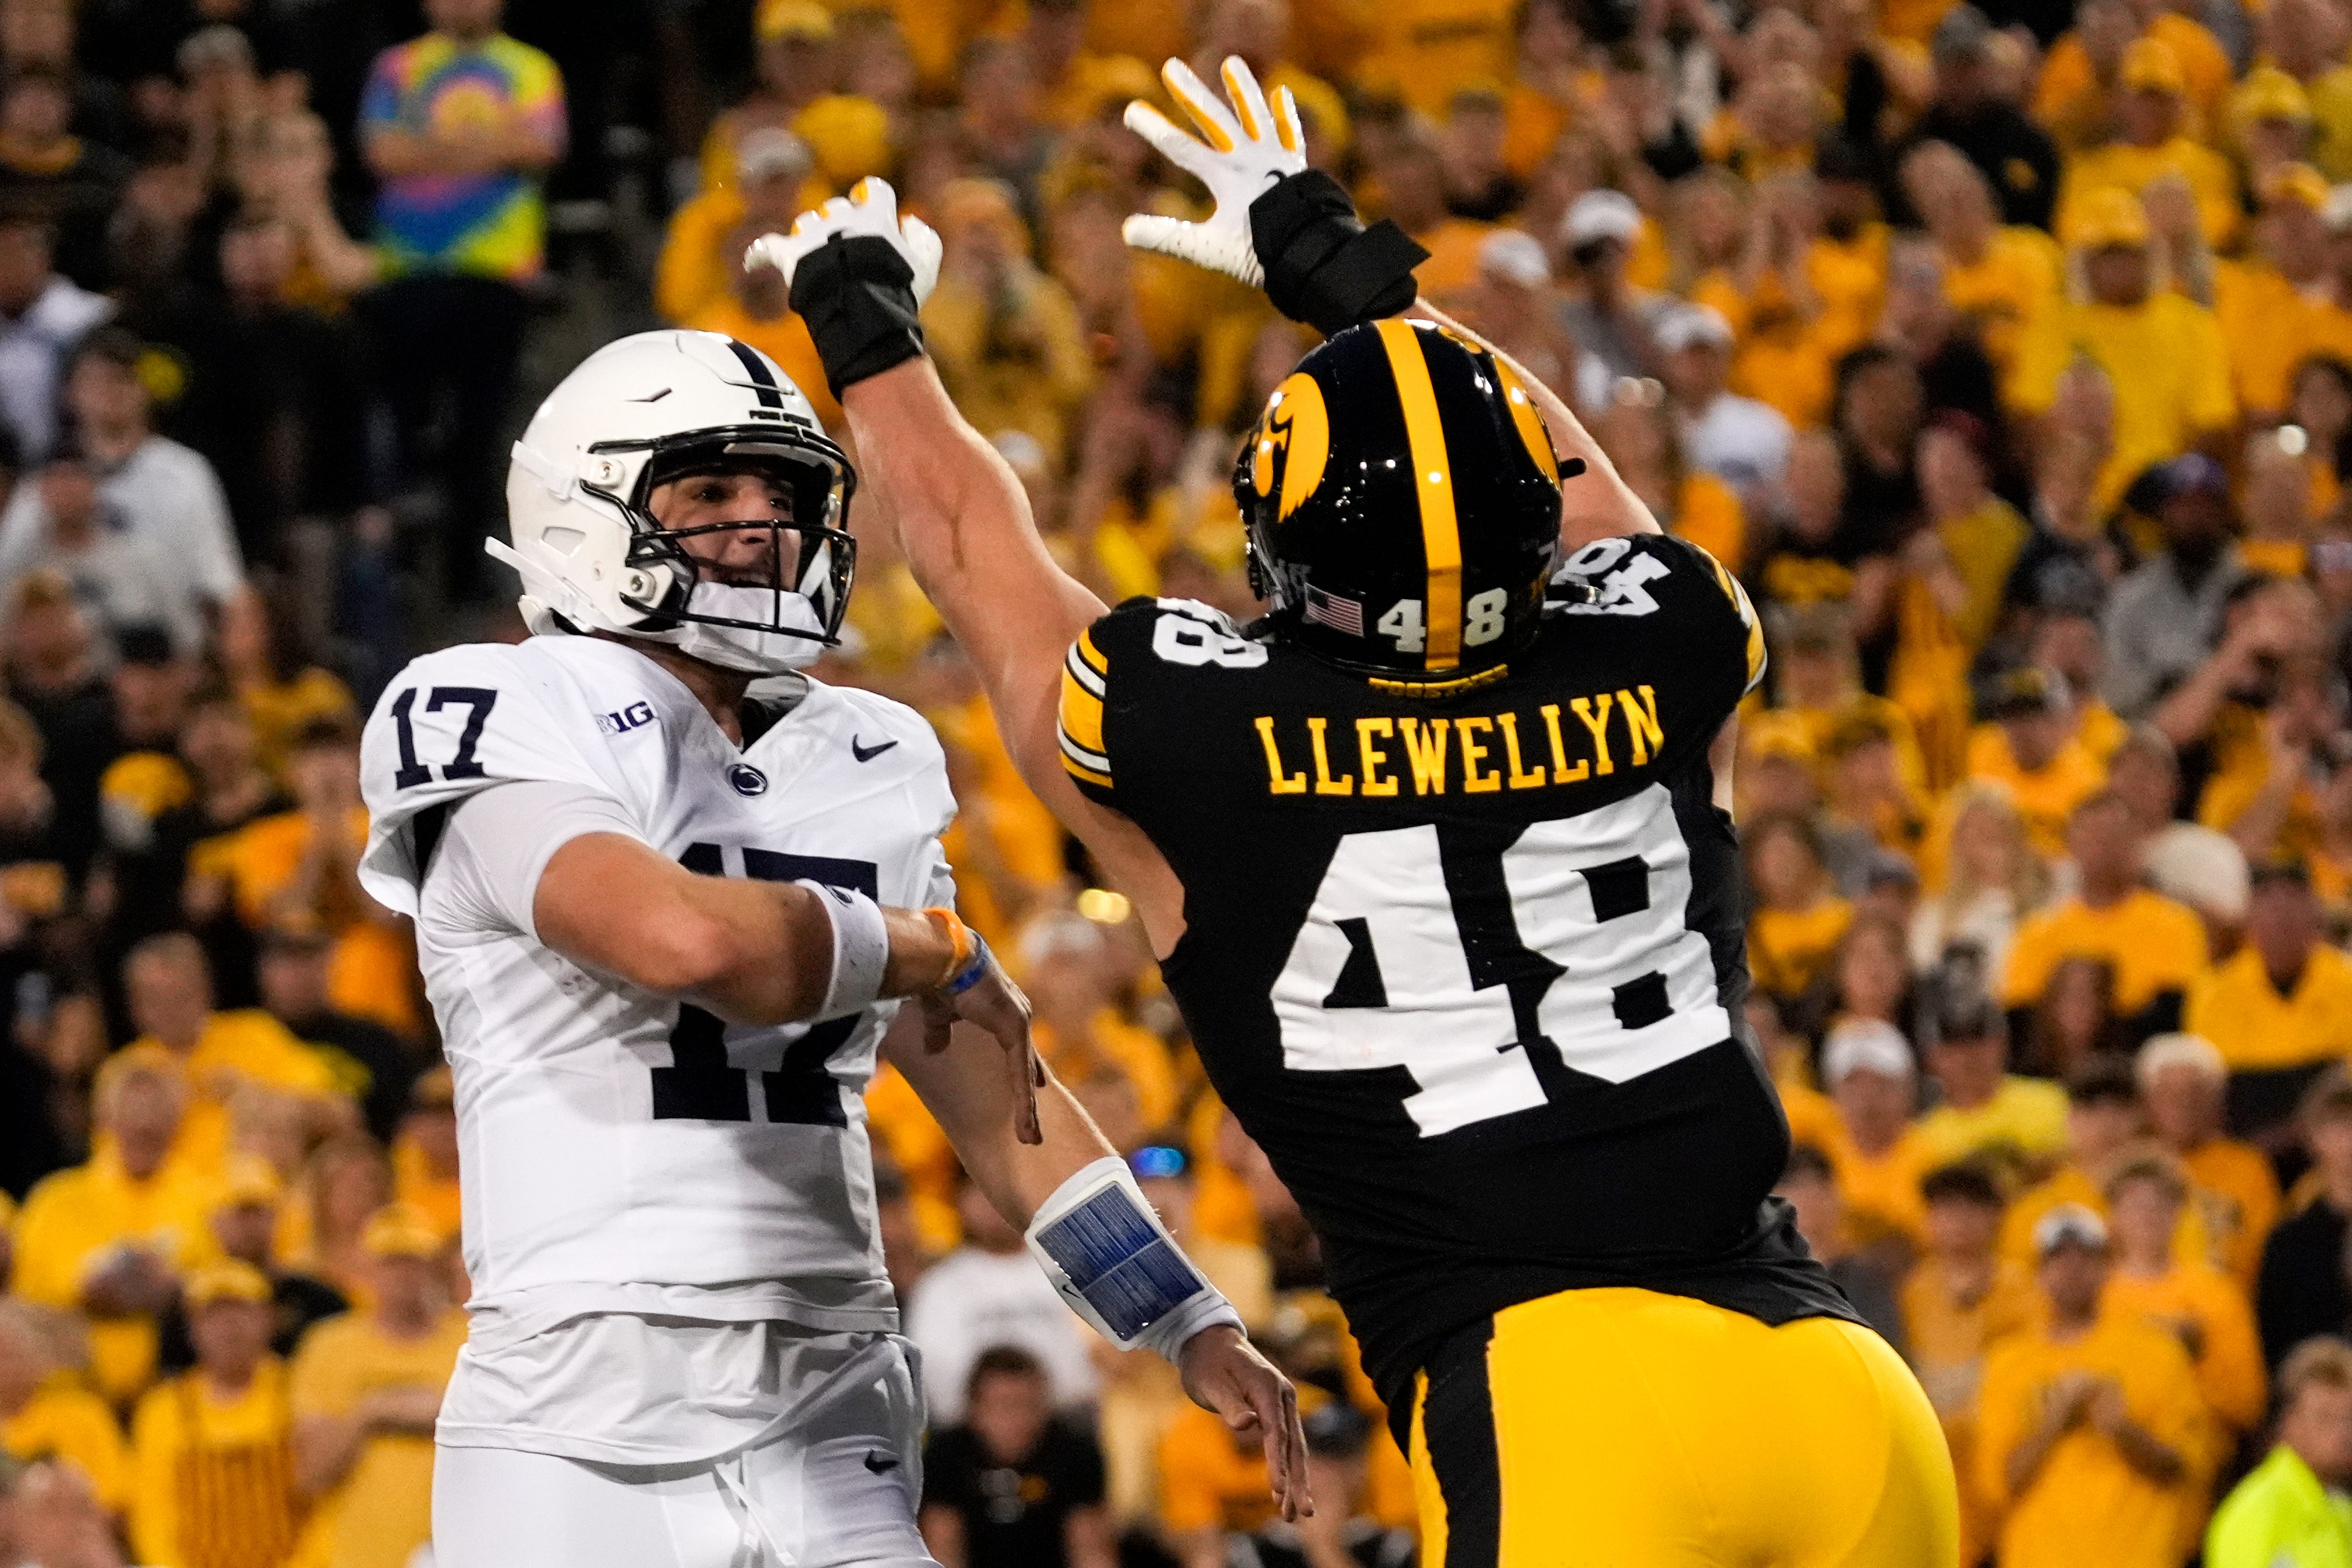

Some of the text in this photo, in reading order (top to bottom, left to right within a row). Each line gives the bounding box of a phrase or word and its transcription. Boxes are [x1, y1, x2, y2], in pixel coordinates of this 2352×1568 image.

[391, 687, 497, 790] 17
[1254, 685, 1665, 796] LLEWELLYN
[1270, 782, 1731, 1139] 48
